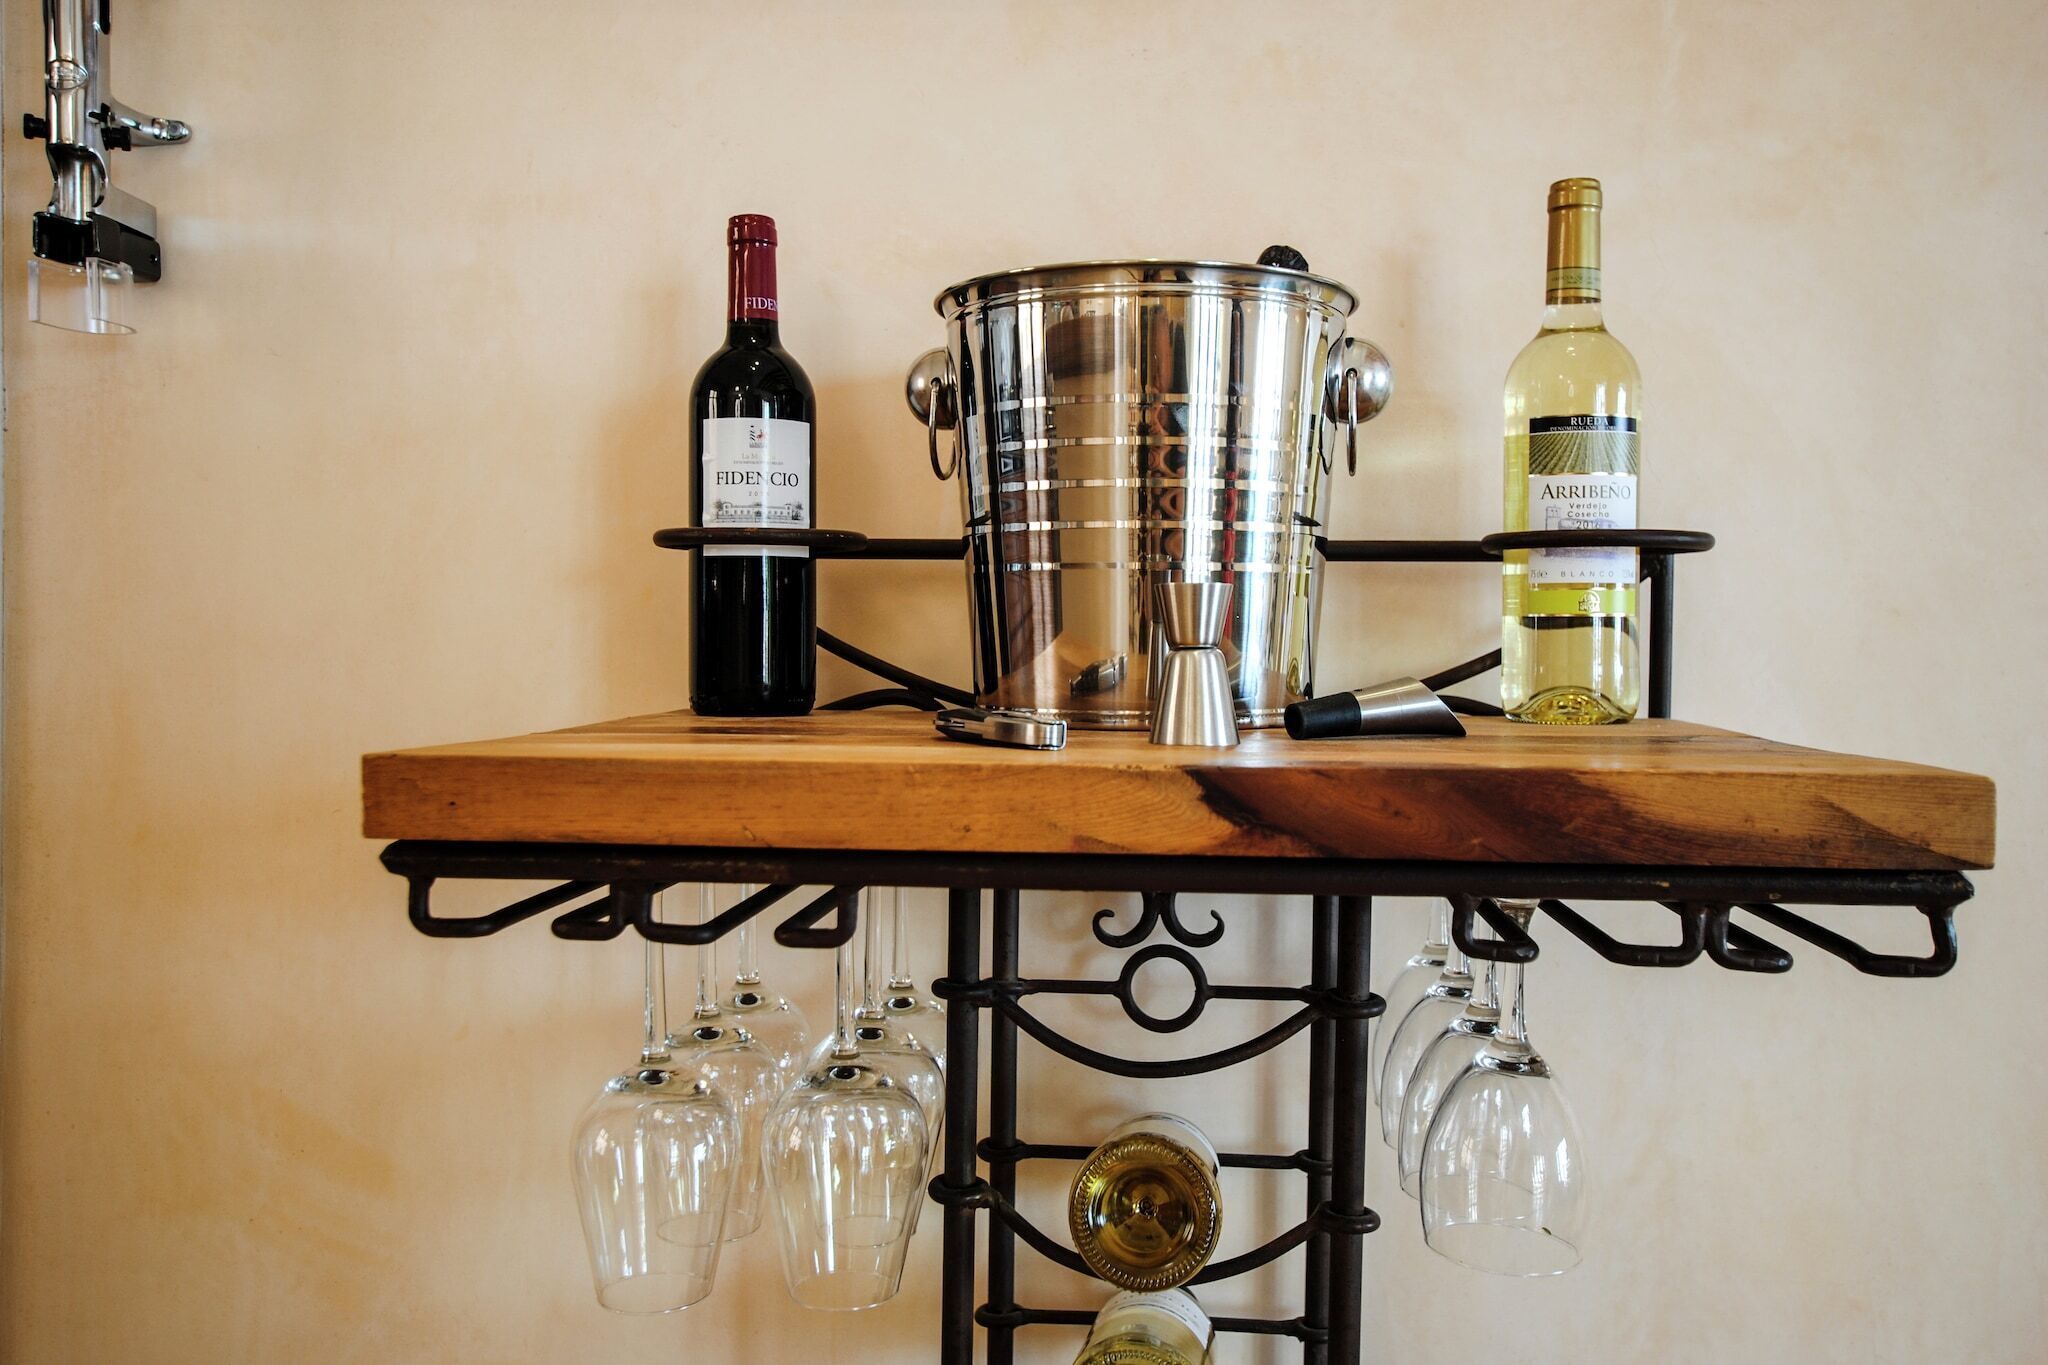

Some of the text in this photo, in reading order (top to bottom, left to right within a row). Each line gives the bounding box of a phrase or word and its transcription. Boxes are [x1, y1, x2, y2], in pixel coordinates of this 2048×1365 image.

[1570, 416, 1609, 426] RUEDA
[716, 471, 799, 487] FIDENCIO
[1541, 482, 1631, 500] ARRIBEÑO
[1569, 501, 1608, 512] Verdejo
[1567, 510, 1610, 518] Cosecha
[1560, 570, 1615, 578] BLANCO
